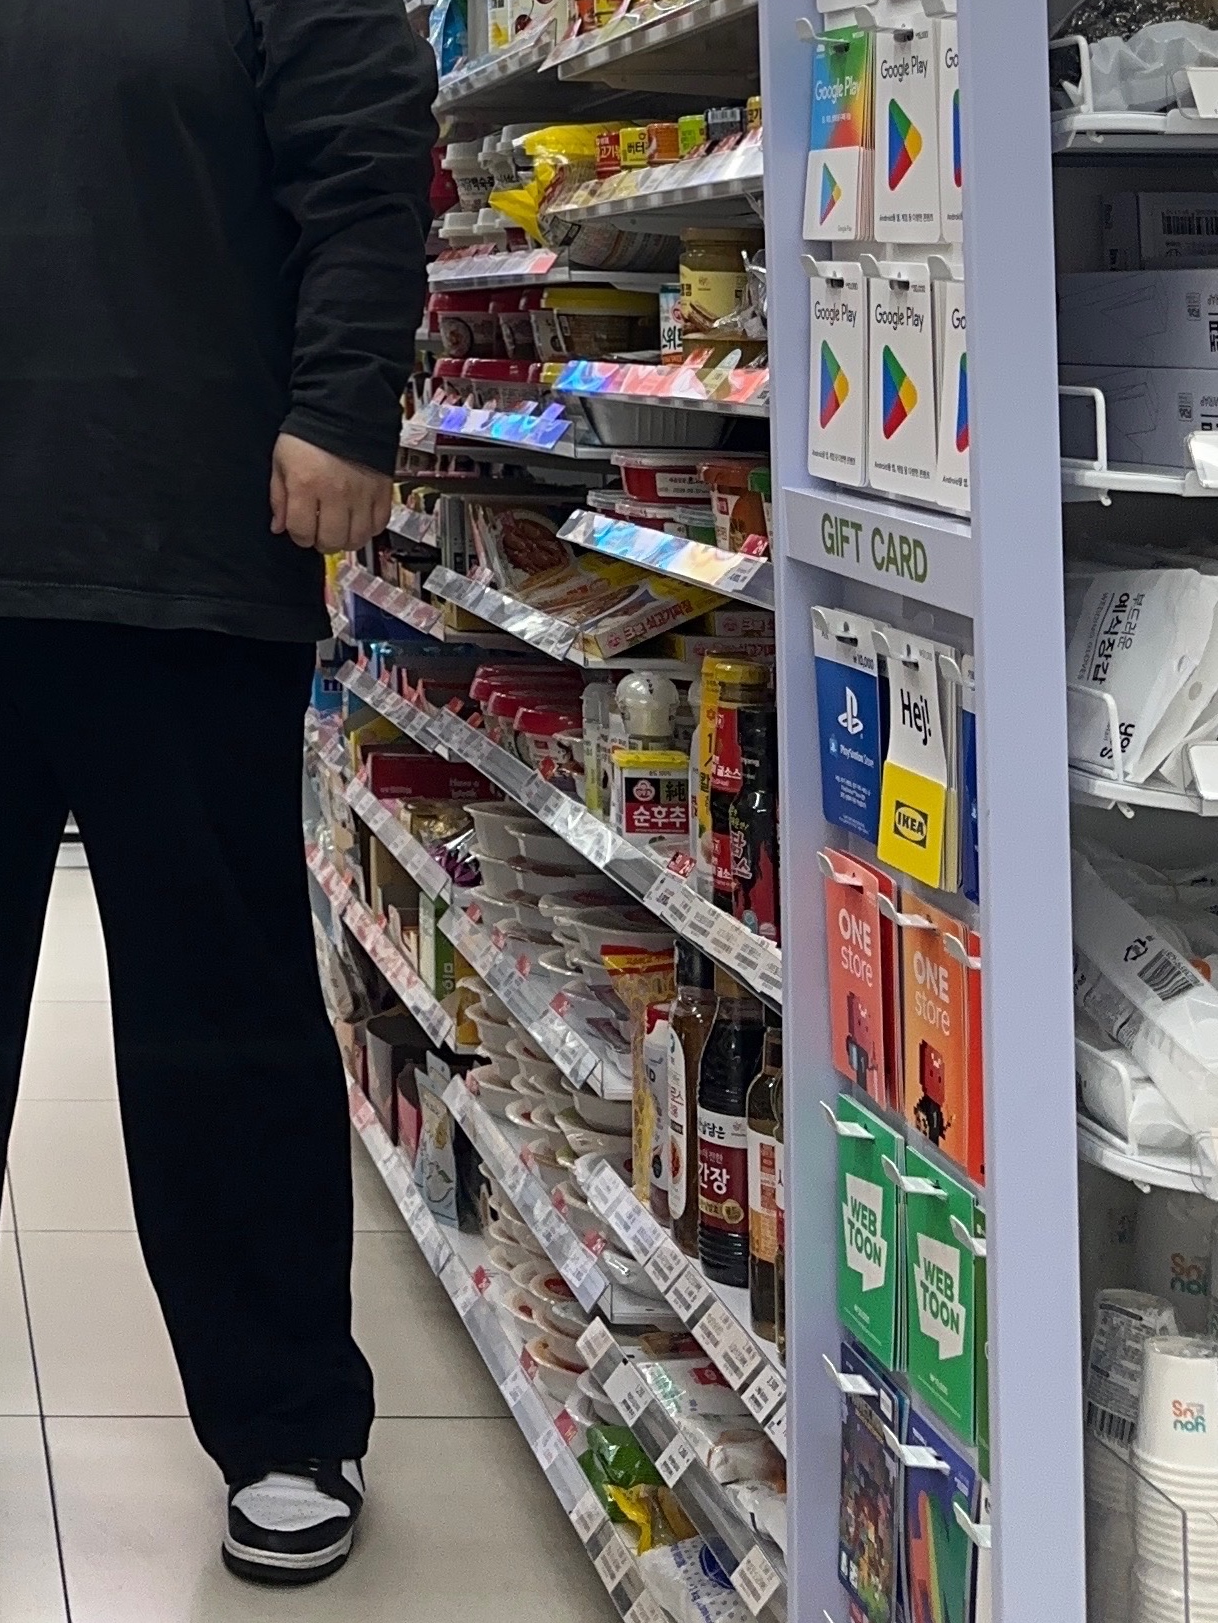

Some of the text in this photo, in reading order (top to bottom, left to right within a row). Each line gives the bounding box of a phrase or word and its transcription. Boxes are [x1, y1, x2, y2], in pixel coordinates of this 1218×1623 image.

[814, 75, 861, 104] Google Play
[880, 58, 910, 83] Google
[911, 57, 928, 78] Play
[815, 300, 857, 328] Google Play
[875, 304, 904, 331] Google
[906, 306, 924, 333] Play
[821, 512, 928, 584] GIFT CARD
[1092, 593, 1131, 685] 예식장갑
[1117, 593, 1146, 651] 부드러운
[900, 687, 932, 746] Hej!
[632, 804, 687, 829] 순후추
[896, 813, 925, 835] IKEA
[838, 907, 872, 957] ONE
[840, 944, 874, 988] store
[913, 951, 950, 1004] ONE
[914, 989, 951, 1037] store
[850, 1195, 878, 1234] WEB
[847, 1222, 882, 1268] TOON
[923, 1257, 955, 1301] WEB
[919, 1284, 960, 1336] TOON
